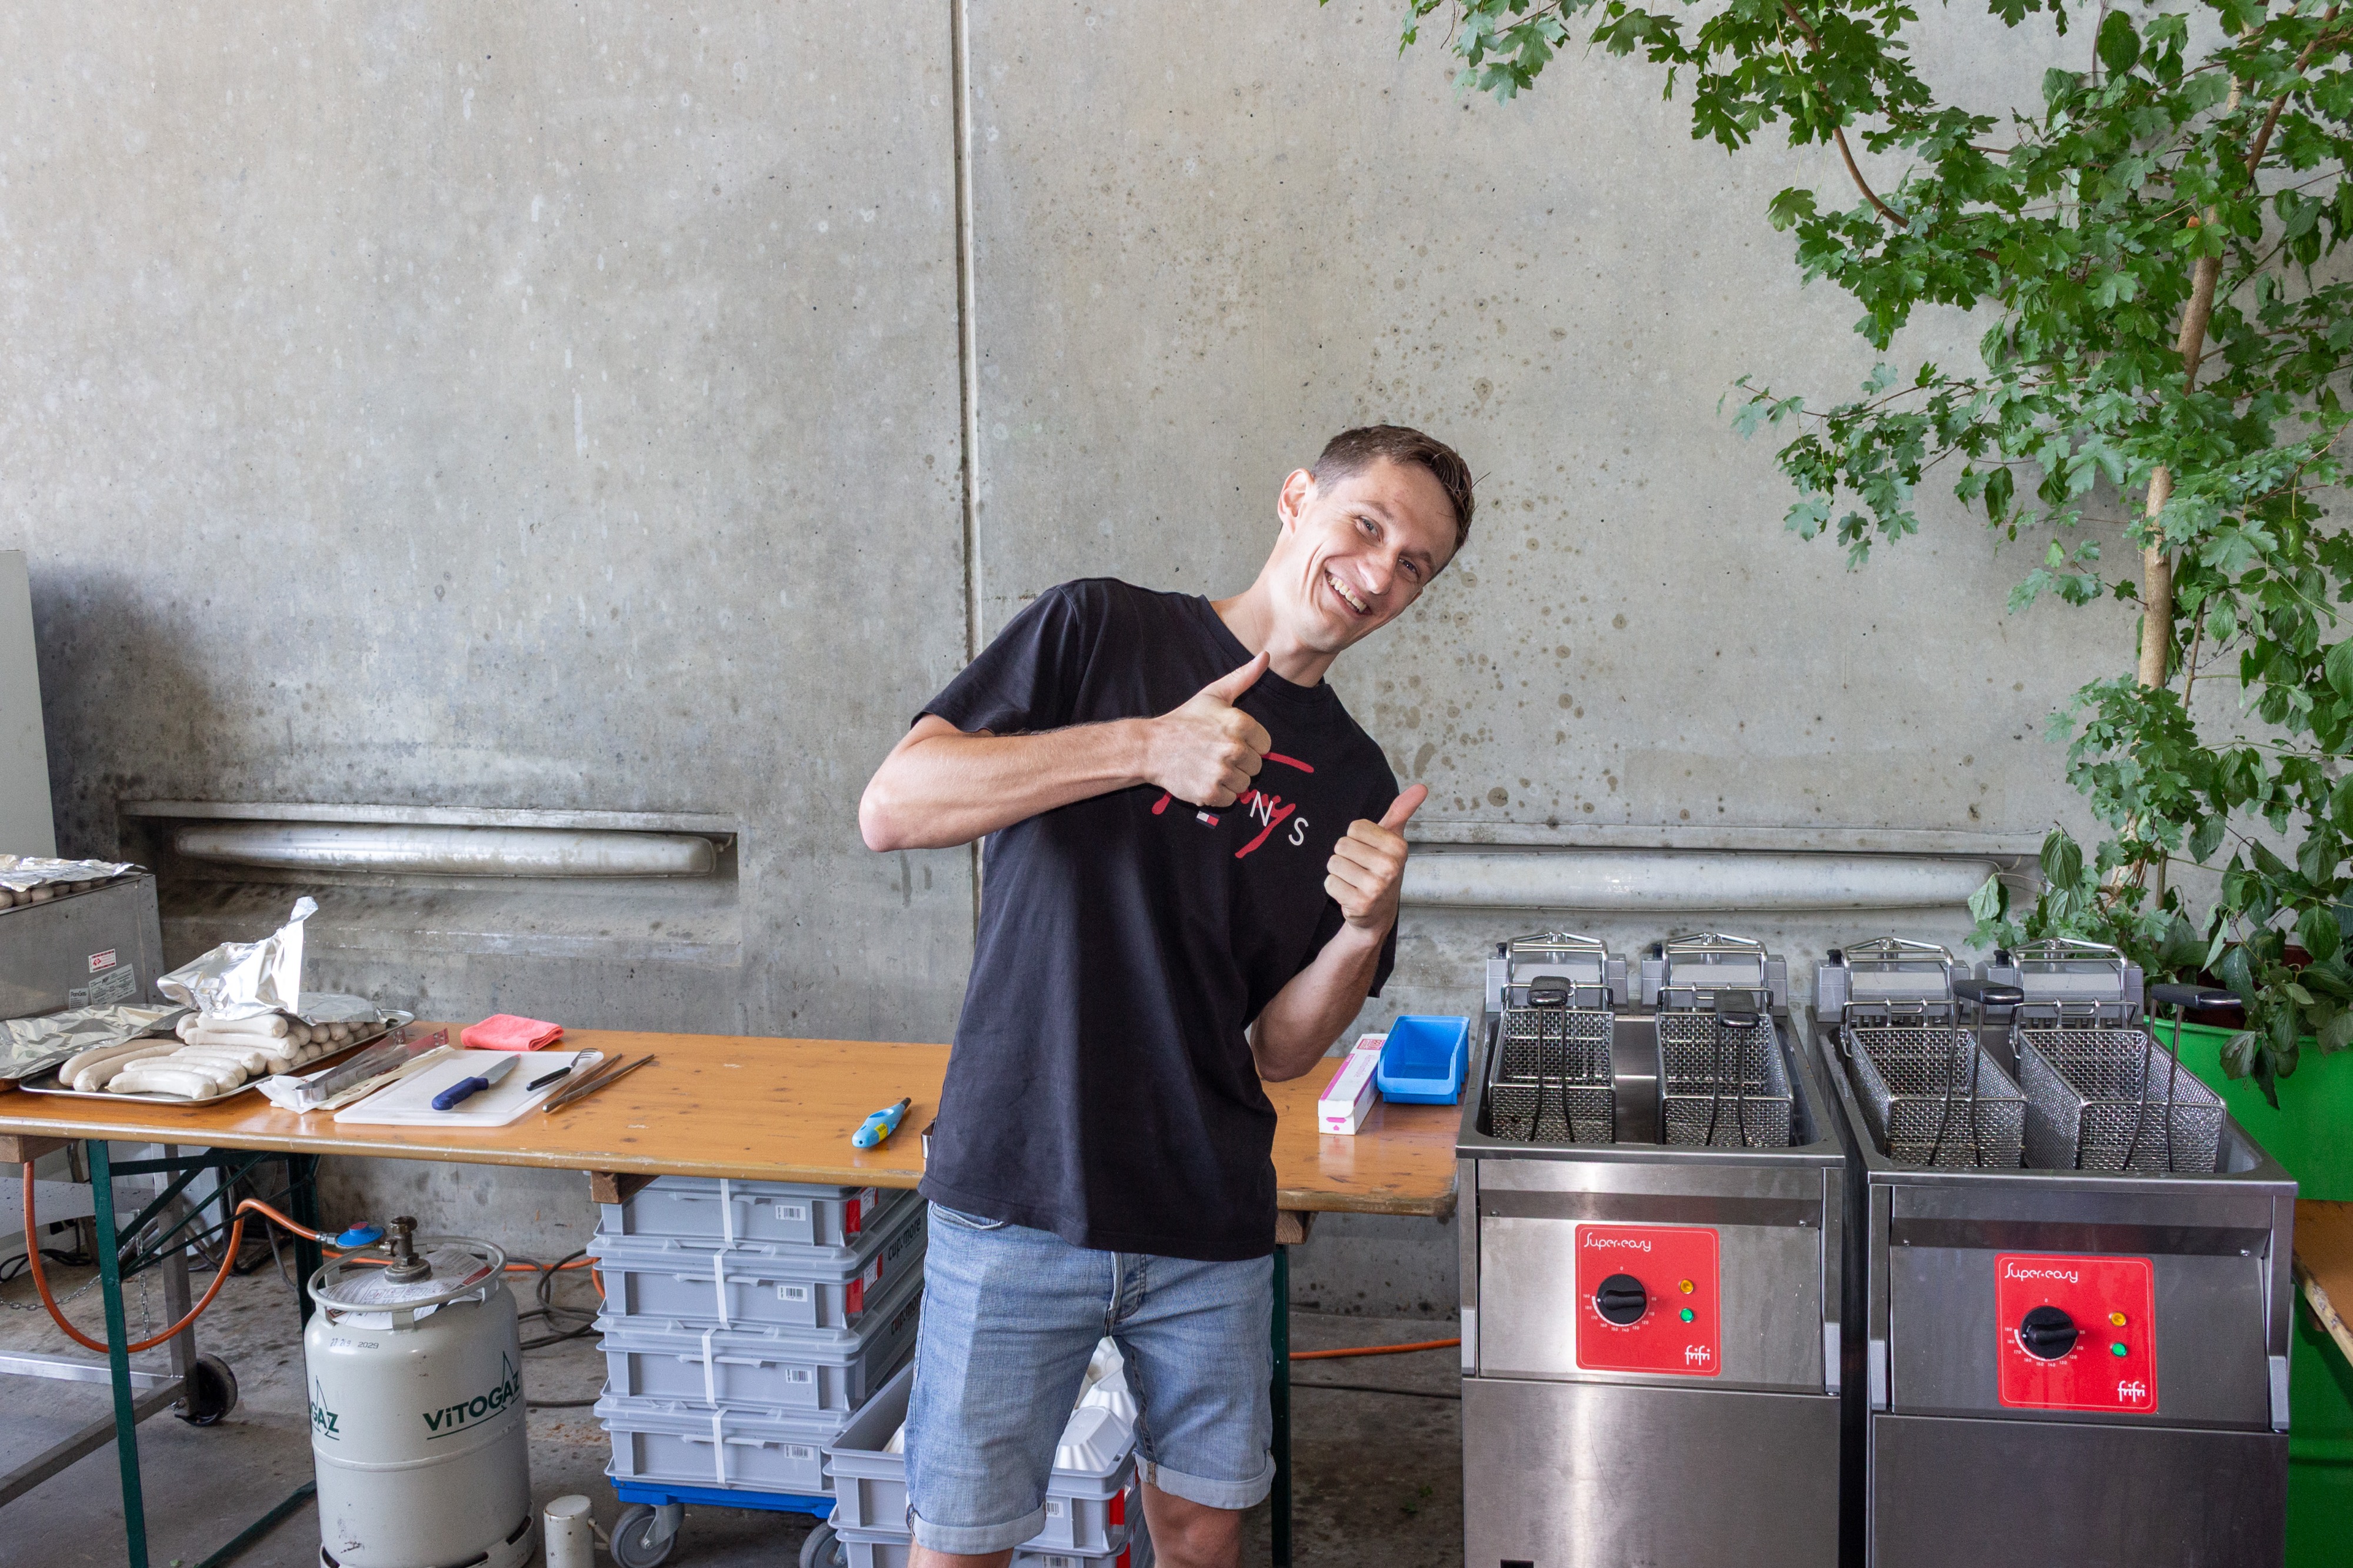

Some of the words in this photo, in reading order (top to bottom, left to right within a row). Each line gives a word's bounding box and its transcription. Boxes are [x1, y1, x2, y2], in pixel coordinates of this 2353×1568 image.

[358, 1341, 379, 1349] 2029
[1684, 1345, 1711, 1366] frifri
[2117, 1380, 2146, 1403] frifri
